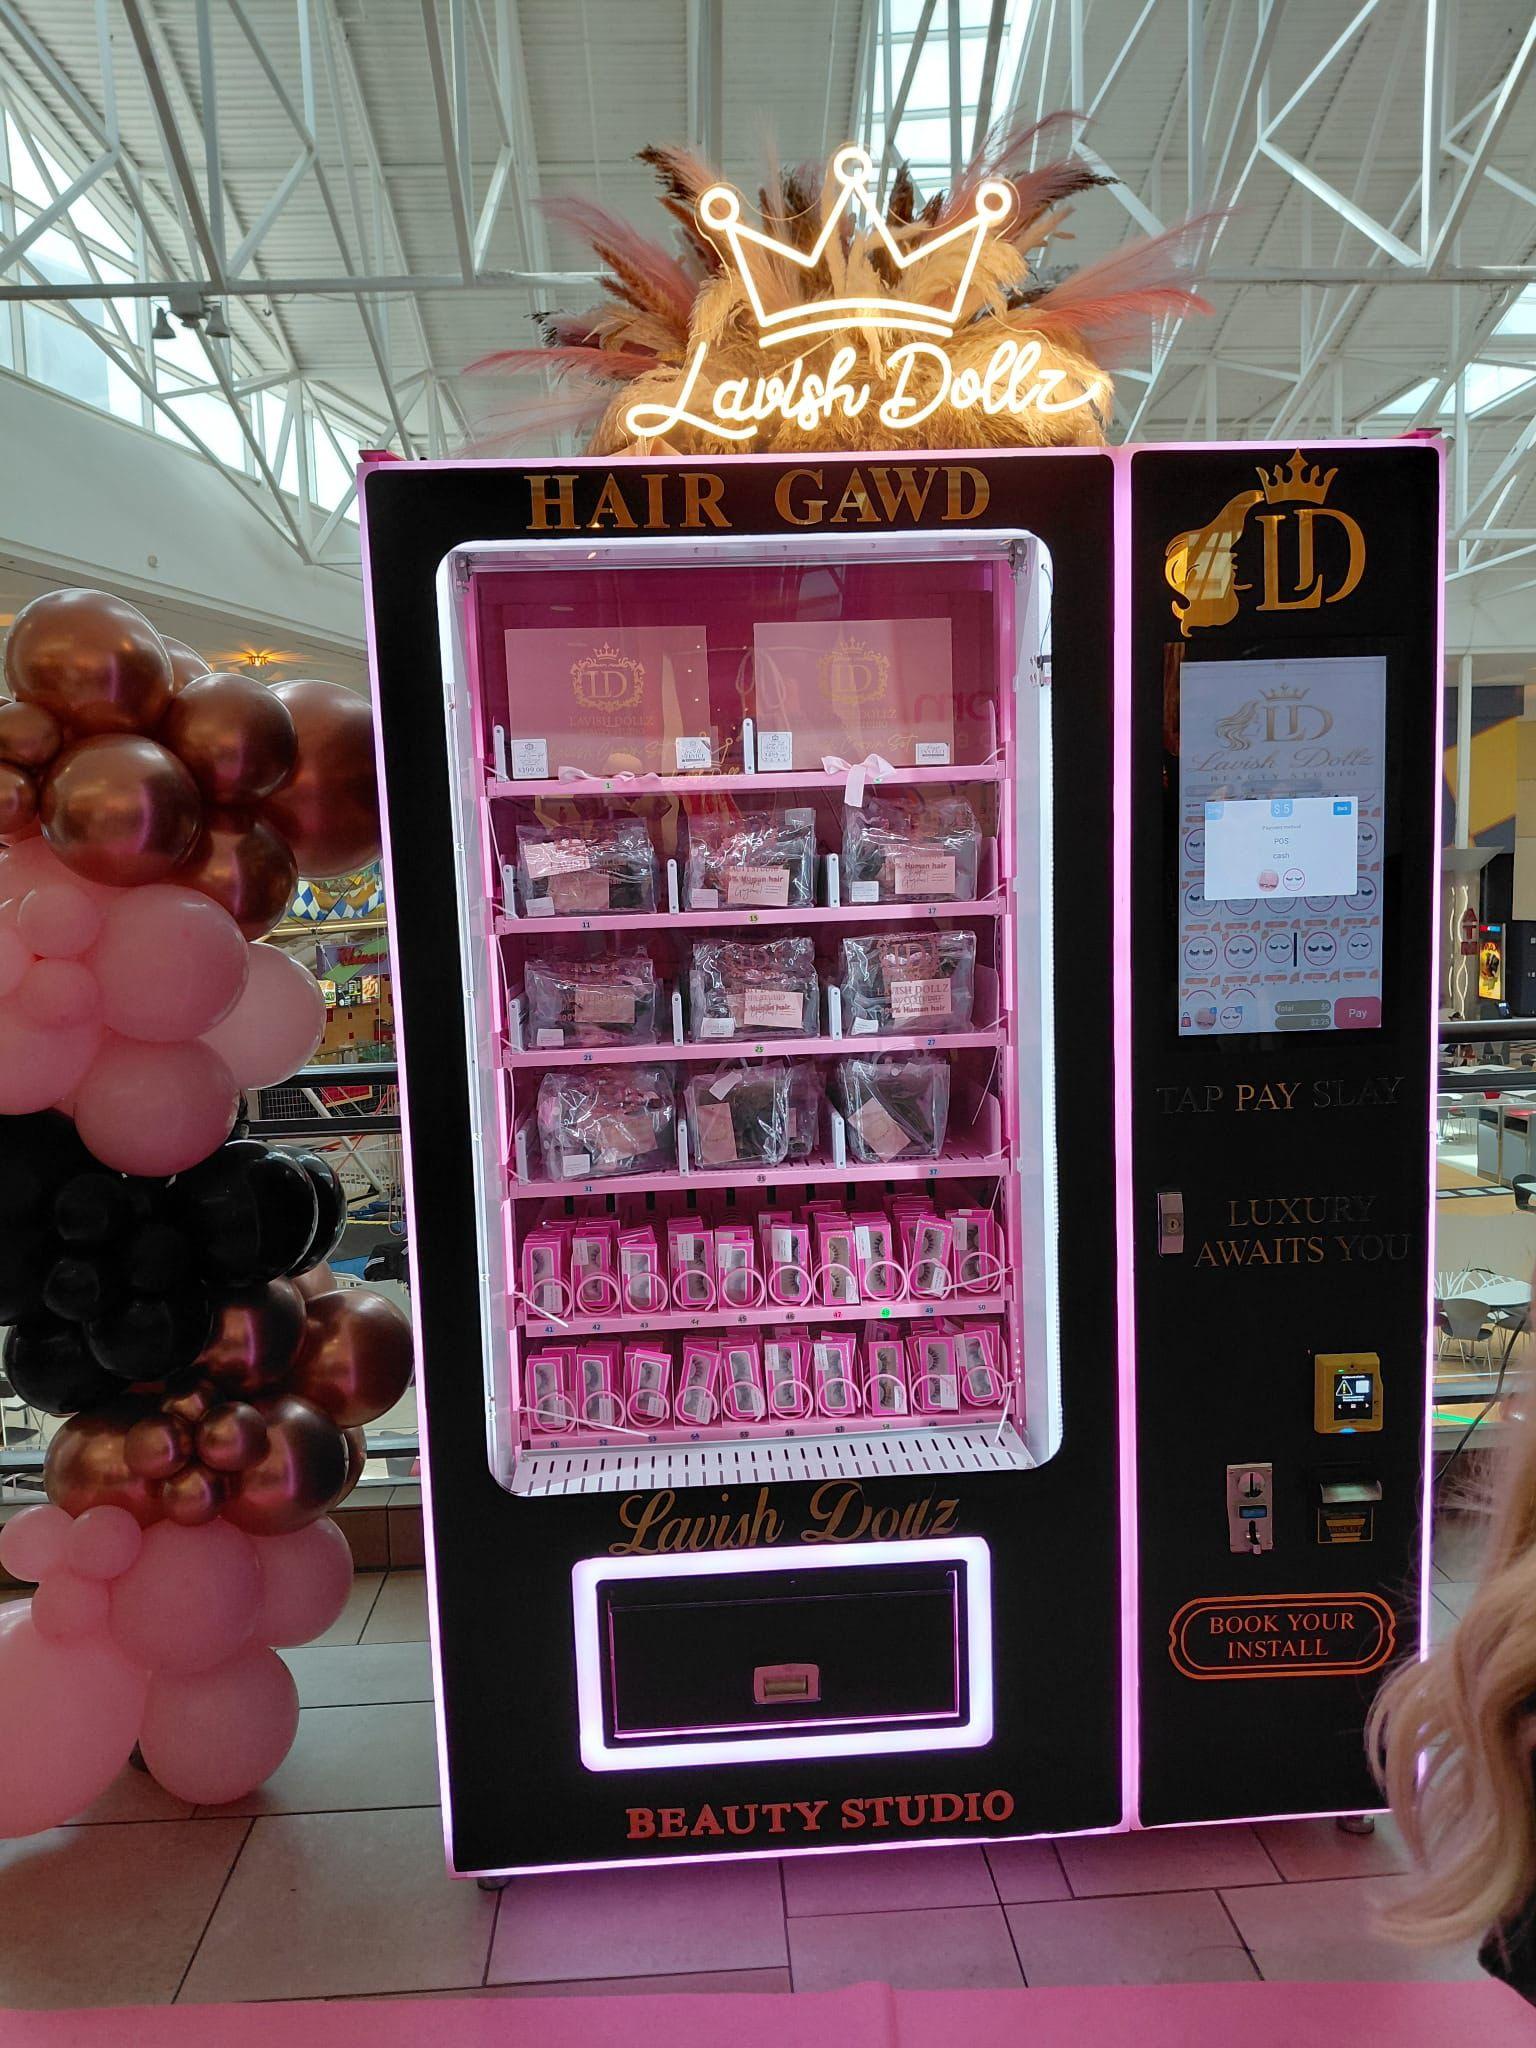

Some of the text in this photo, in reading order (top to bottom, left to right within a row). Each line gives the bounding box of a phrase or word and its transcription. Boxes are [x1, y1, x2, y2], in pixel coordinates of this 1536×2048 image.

[625, 339, 1103, 440] Lavish Dollz
[523, 465, 991, 530] HAIR GAWD
[1254, 508, 1367, 611] LD
[1263, 704, 1335, 743] LD
[1186, 747, 1376, 773] Lavish Dollz
[1273, 837, 1289, 845] POS
[904, 861, 948, 870] Human hair
[741, 875, 784, 884] Human hair
[749, 914, 759, 922] 15
[1461, 908, 1478, 955] ATM
[914, 983, 949, 994] DOLLZ
[930, 1004, 945, 1012] hair
[1348, 1008, 1368, 1020] Pay
[754, 1045, 764, 1053] 25
[1156, 1076, 1405, 1114] TAP PAY SLAY
[1227, 1195, 1377, 1227] LUXURY
[1193, 1233, 1412, 1268] AWAITS YOU
[608, 1480, 961, 1556] Lavish Dollz
[1209, 1612, 1355, 1635] BOOK YOUR
[1228, 1638, 1329, 1659] INSTALL
[625, 1788, 1016, 1840] BEAUTY STUDIO
